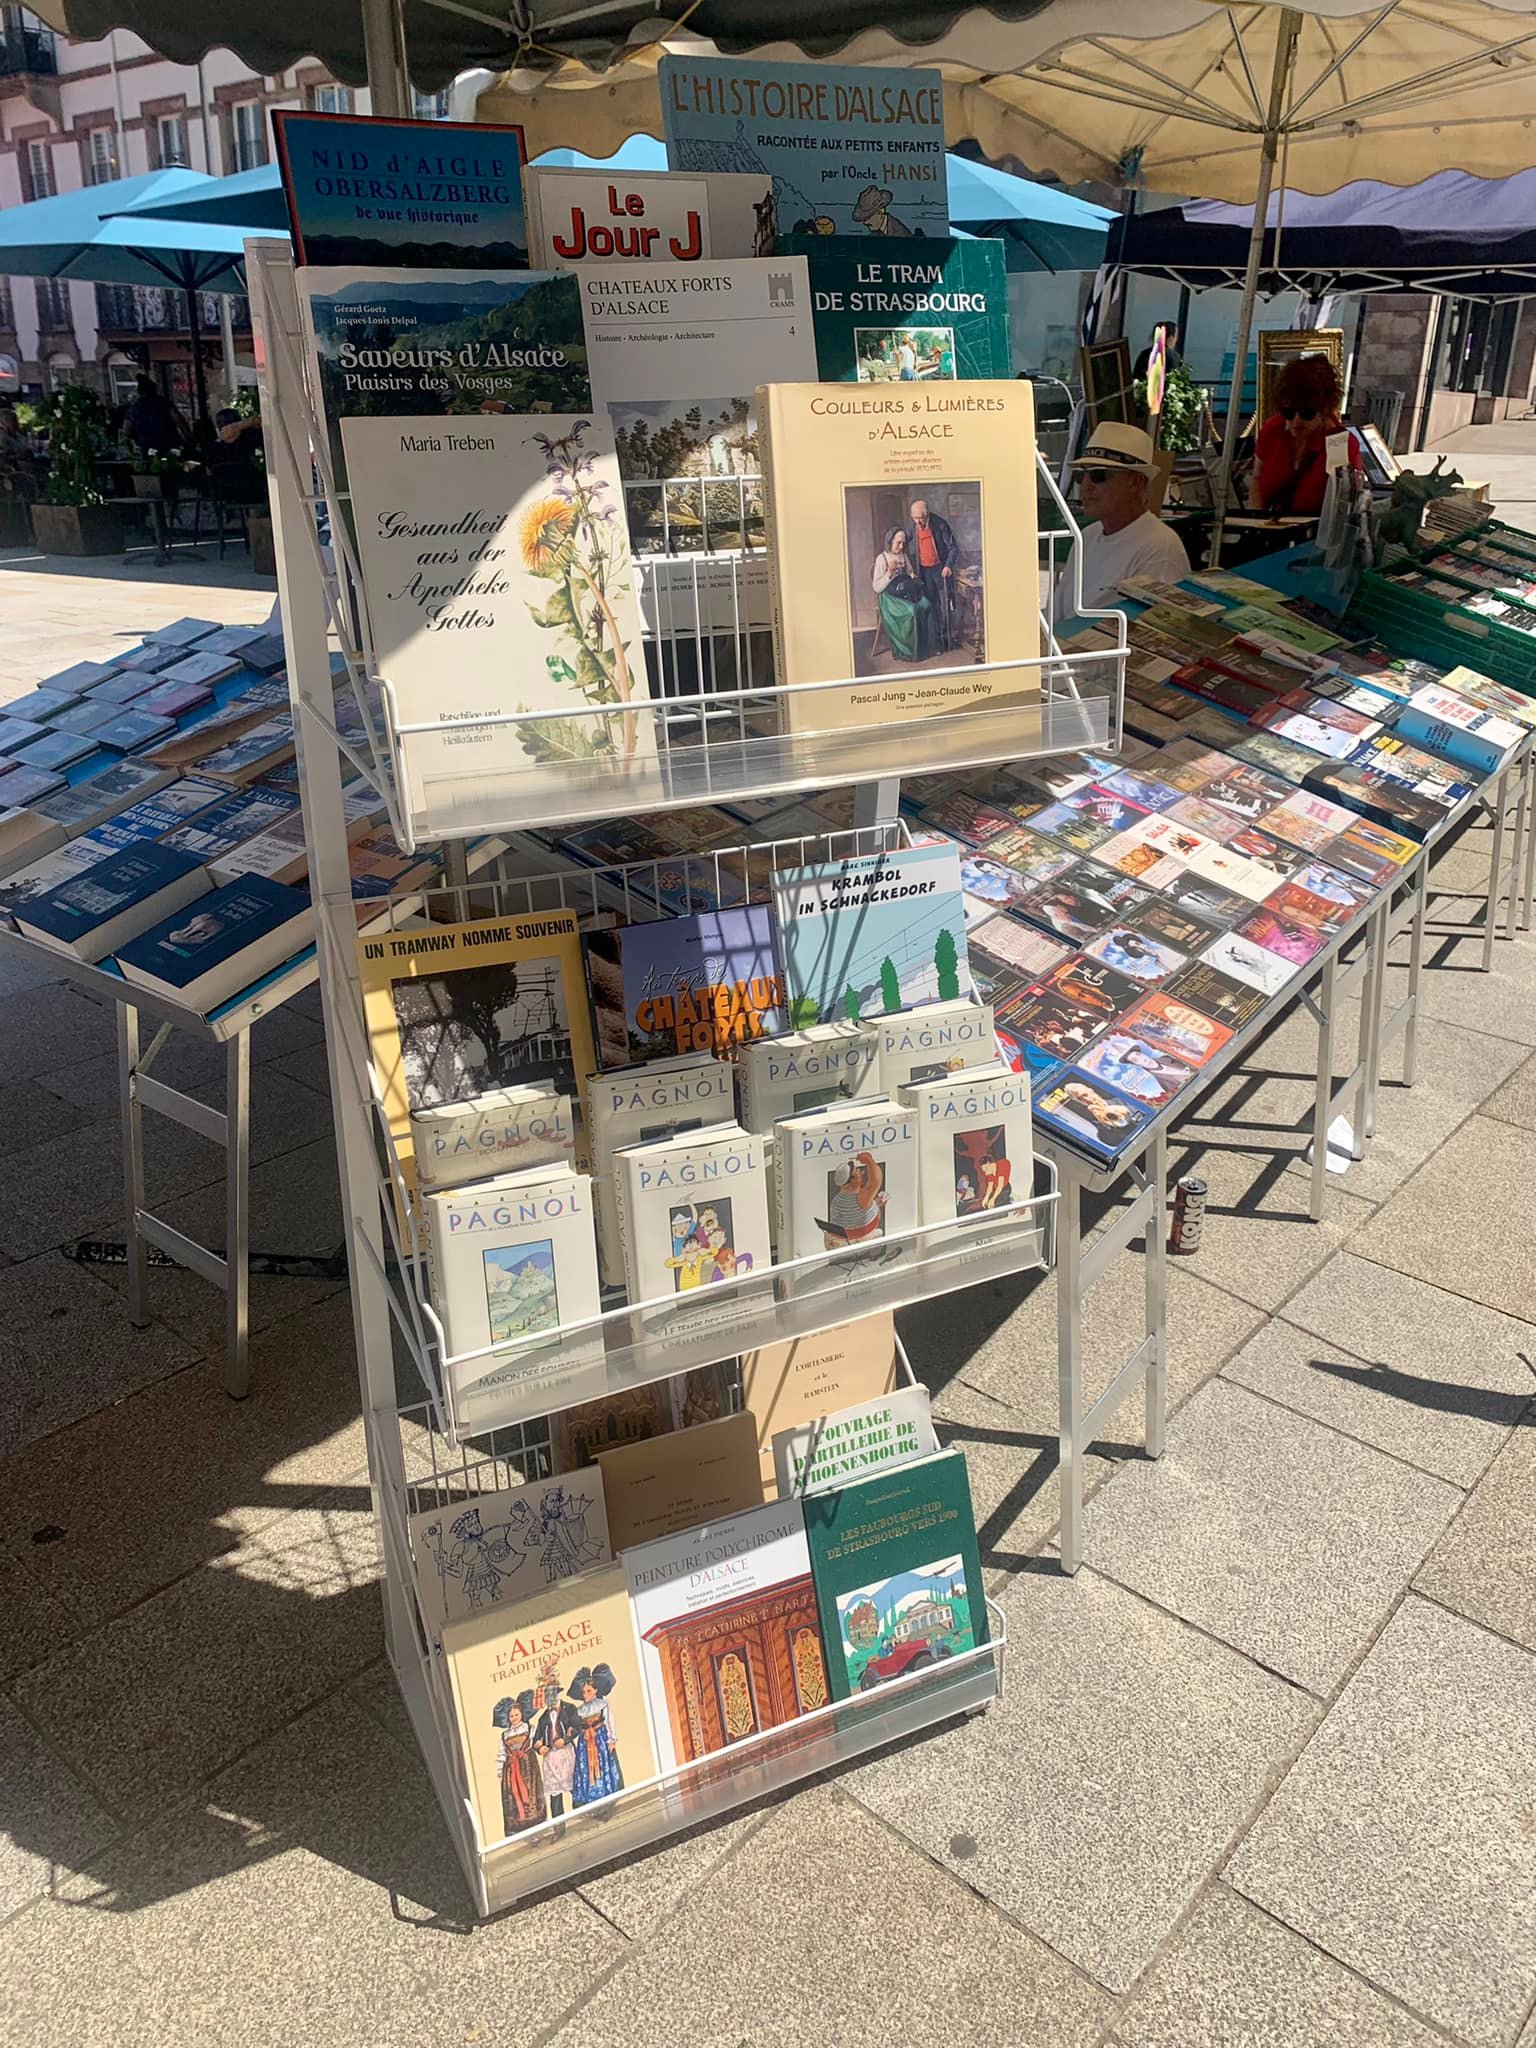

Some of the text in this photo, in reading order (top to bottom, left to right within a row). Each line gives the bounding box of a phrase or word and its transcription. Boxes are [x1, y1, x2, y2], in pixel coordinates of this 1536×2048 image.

[673, 73, 941, 125] L'HISTOIRE D'ALSACE
[757, 134, 940, 153] RACONTÉE AUX PETITS ENFANTS
[312, 149, 505, 178] NID d'AIGLE
[821, 168, 839, 183] par
[842, 165, 877, 181] l'Oncle
[315, 177, 510, 205] OBERSALZBERG
[608, 185, 645, 216] Le
[552, 207, 704, 261] Jour J
[587, 276, 732, 295] CHATEAUX FORTS
[857, 265, 943, 284] LE TRAM
[591, 300, 669, 315] D'ALSACE
[816, 292, 987, 313] DE STRASBOURG
[595, 331, 715, 342] Histoire Archéologie Architecture
[788, 326, 796, 336] 4
[340, 342, 569, 369] Saveurs d'Alsace
[344, 373, 513, 394] Plaisirs des Vosges
[810, 396, 1005, 415] COULEURS & LUMIÈRES
[400, 434, 495, 452] Maria Treben
[378, 508, 508, 539] Gesundheit
[417, 539, 506, 566] aus der
[388, 568, 511, 606] Apotheke
[425, 605, 495, 632] Gottes
[850, 683, 992, 704] Pascal Jung Jean-Claude Wey
[831, 869, 902, 891] KRAMBOL
[799, 881, 937, 916] IN SCHNACKEDORF
[365, 918, 575, 960] UN TRAMWAY NOMME SOUVENIR
[635, 976, 783, 1034] CHÂTEAUX
[675, 1009, 763, 1055] FORTS
[885, 1022, 987, 1052] PAGNOL
[768, 1046, 874, 1081] PAGNOL
[613, 1077, 729, 1112] PAGNOL
[929, 1087, 1027, 1119] PAGNOL
[434, 1114, 566, 1156] PAGNOL
[803, 1124, 912, 1156] PAGNOL
[640, 1153, 757, 1189] PAGNOL
[448, 1195, 582, 1232] PAGNOL
[479, 1372, 520, 1387] MANON
[896, 1420, 918, 1437] DE
[839, 1500, 942, 1542] LES FAUBOURGS SUD
[826, 1546, 842, 1561] DE
[843, 1524, 910, 1556] STRASBOURG
[911, 1515, 937, 1532] VERS
[633, 1522, 795, 1587] PEINTURE POLYCHROME
[495, 1619, 593, 1668] L'ALSACE
[489, 1635, 603, 1683] TRADITIONALISTE
